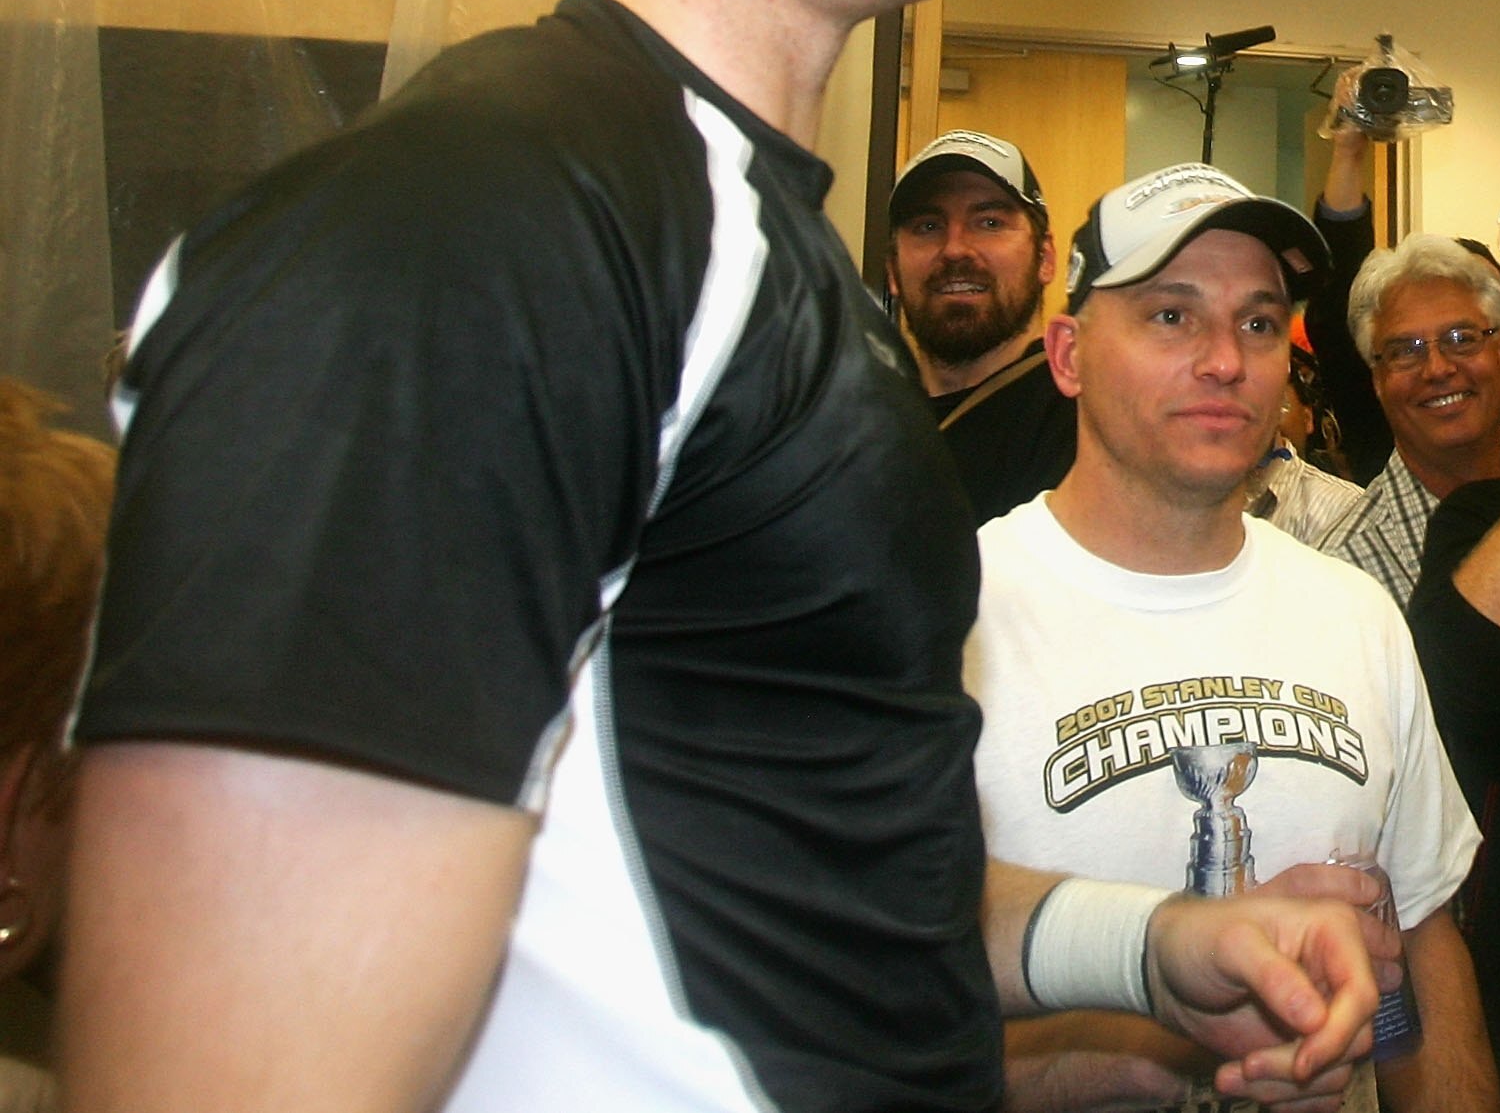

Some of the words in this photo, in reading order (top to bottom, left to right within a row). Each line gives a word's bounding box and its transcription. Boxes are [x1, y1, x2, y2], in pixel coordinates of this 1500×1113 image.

[1056, 690, 1135, 742] 2007
[1141, 676, 1285, 709] STANLEY
[1292, 683, 1349, 724] CUP
[1046, 705, 1368, 807] CHAMPIONS
